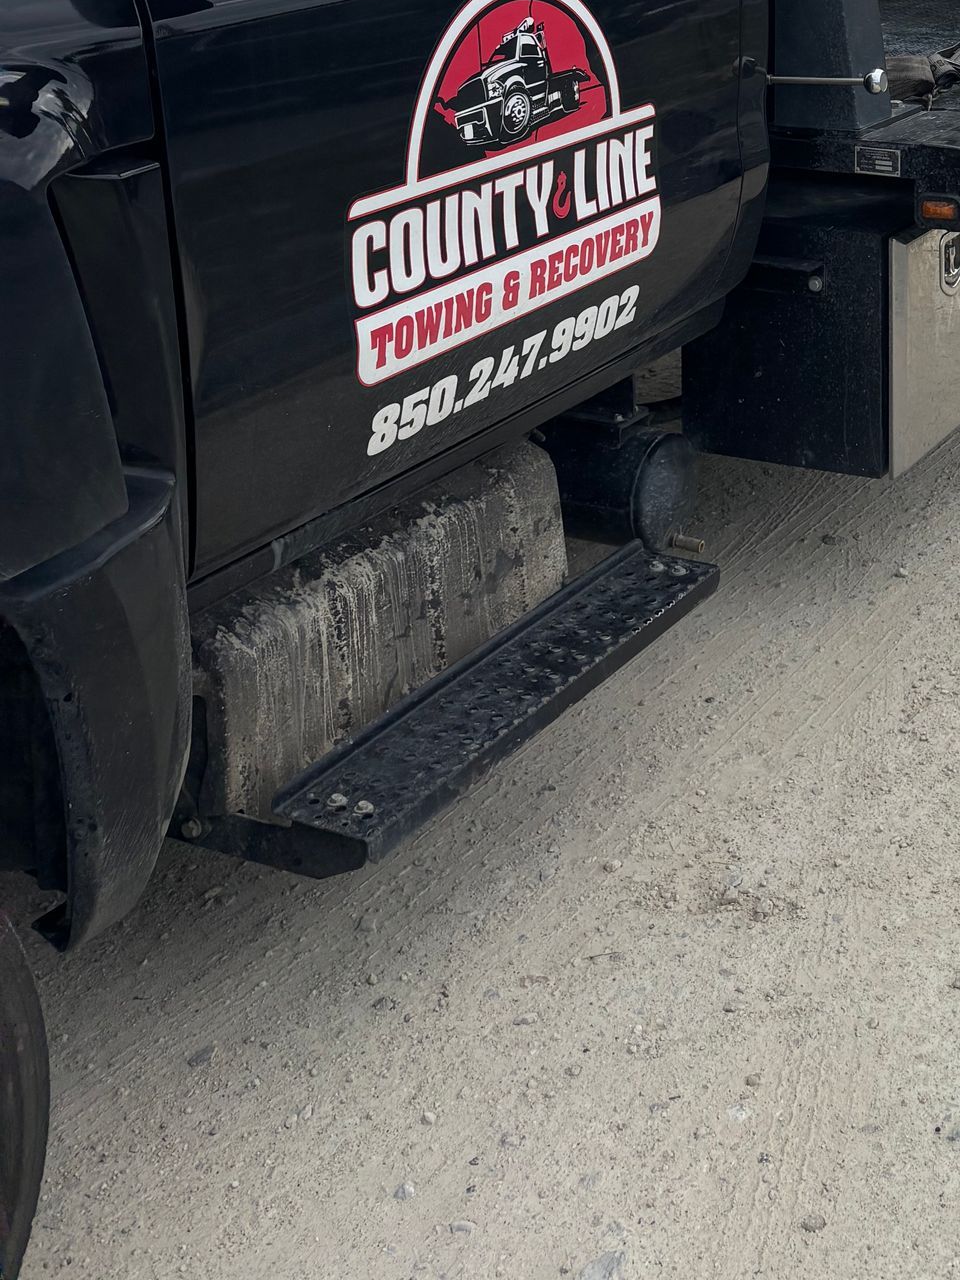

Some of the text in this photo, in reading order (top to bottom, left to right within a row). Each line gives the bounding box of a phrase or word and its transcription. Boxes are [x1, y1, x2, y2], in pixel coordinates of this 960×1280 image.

[352, 124, 657, 309] COUNTY LINE
[370, 211, 655, 370] TOWING & RECOVERY
[366, 284, 641, 457] 850.247.9902
